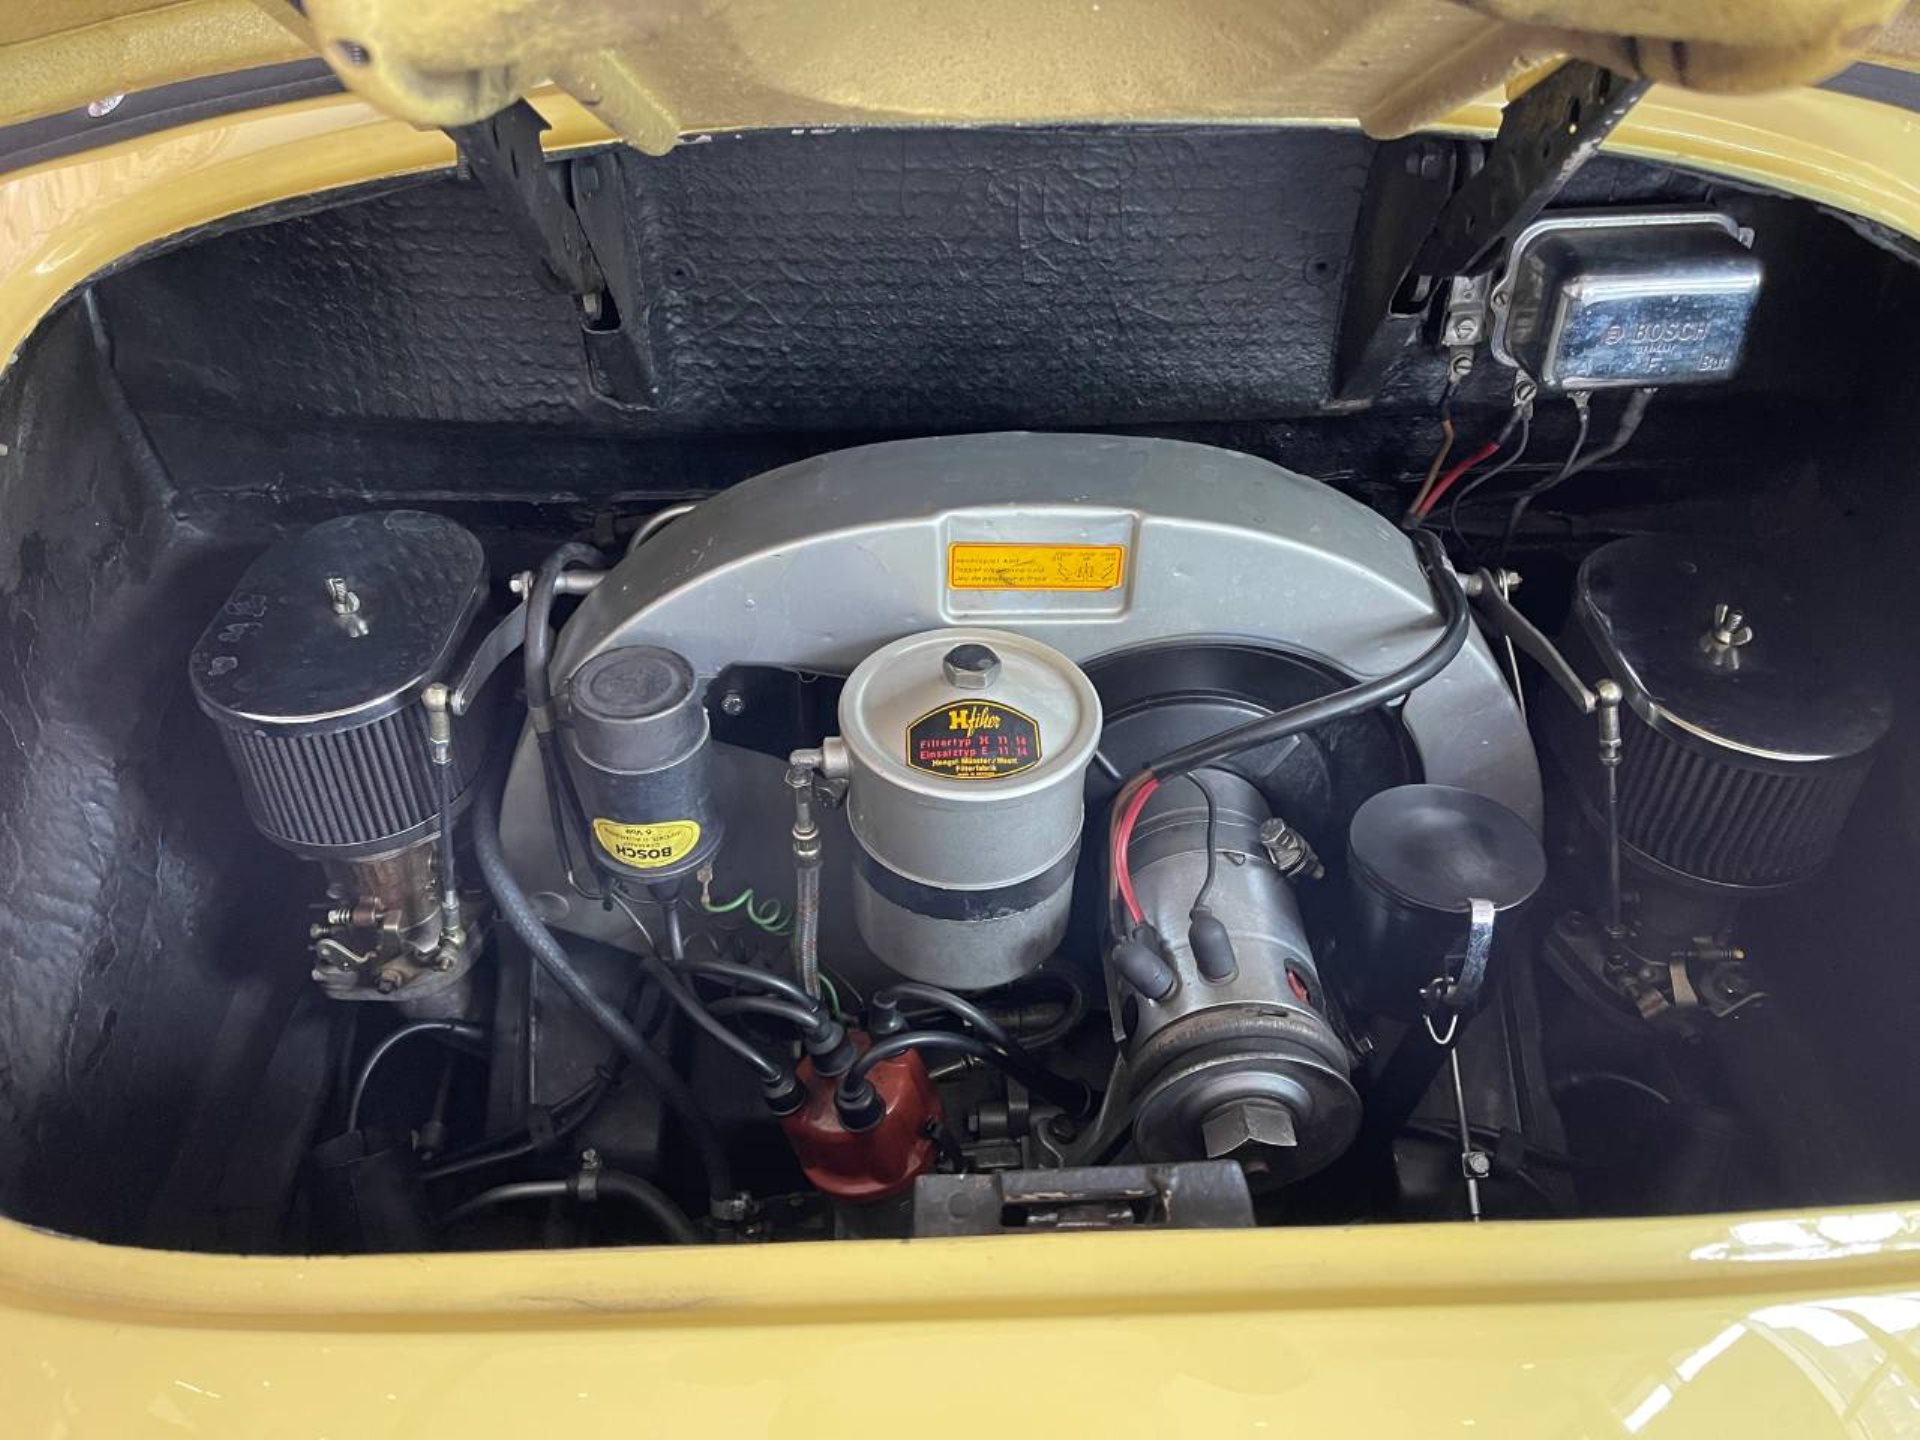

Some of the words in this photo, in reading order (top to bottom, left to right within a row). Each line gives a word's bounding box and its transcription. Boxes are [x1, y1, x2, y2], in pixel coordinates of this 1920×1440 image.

[1633, 322, 1709, 344] BOSCH
[981, 746, 989, 756] E
[616, 844, 672, 859] BOSCH
